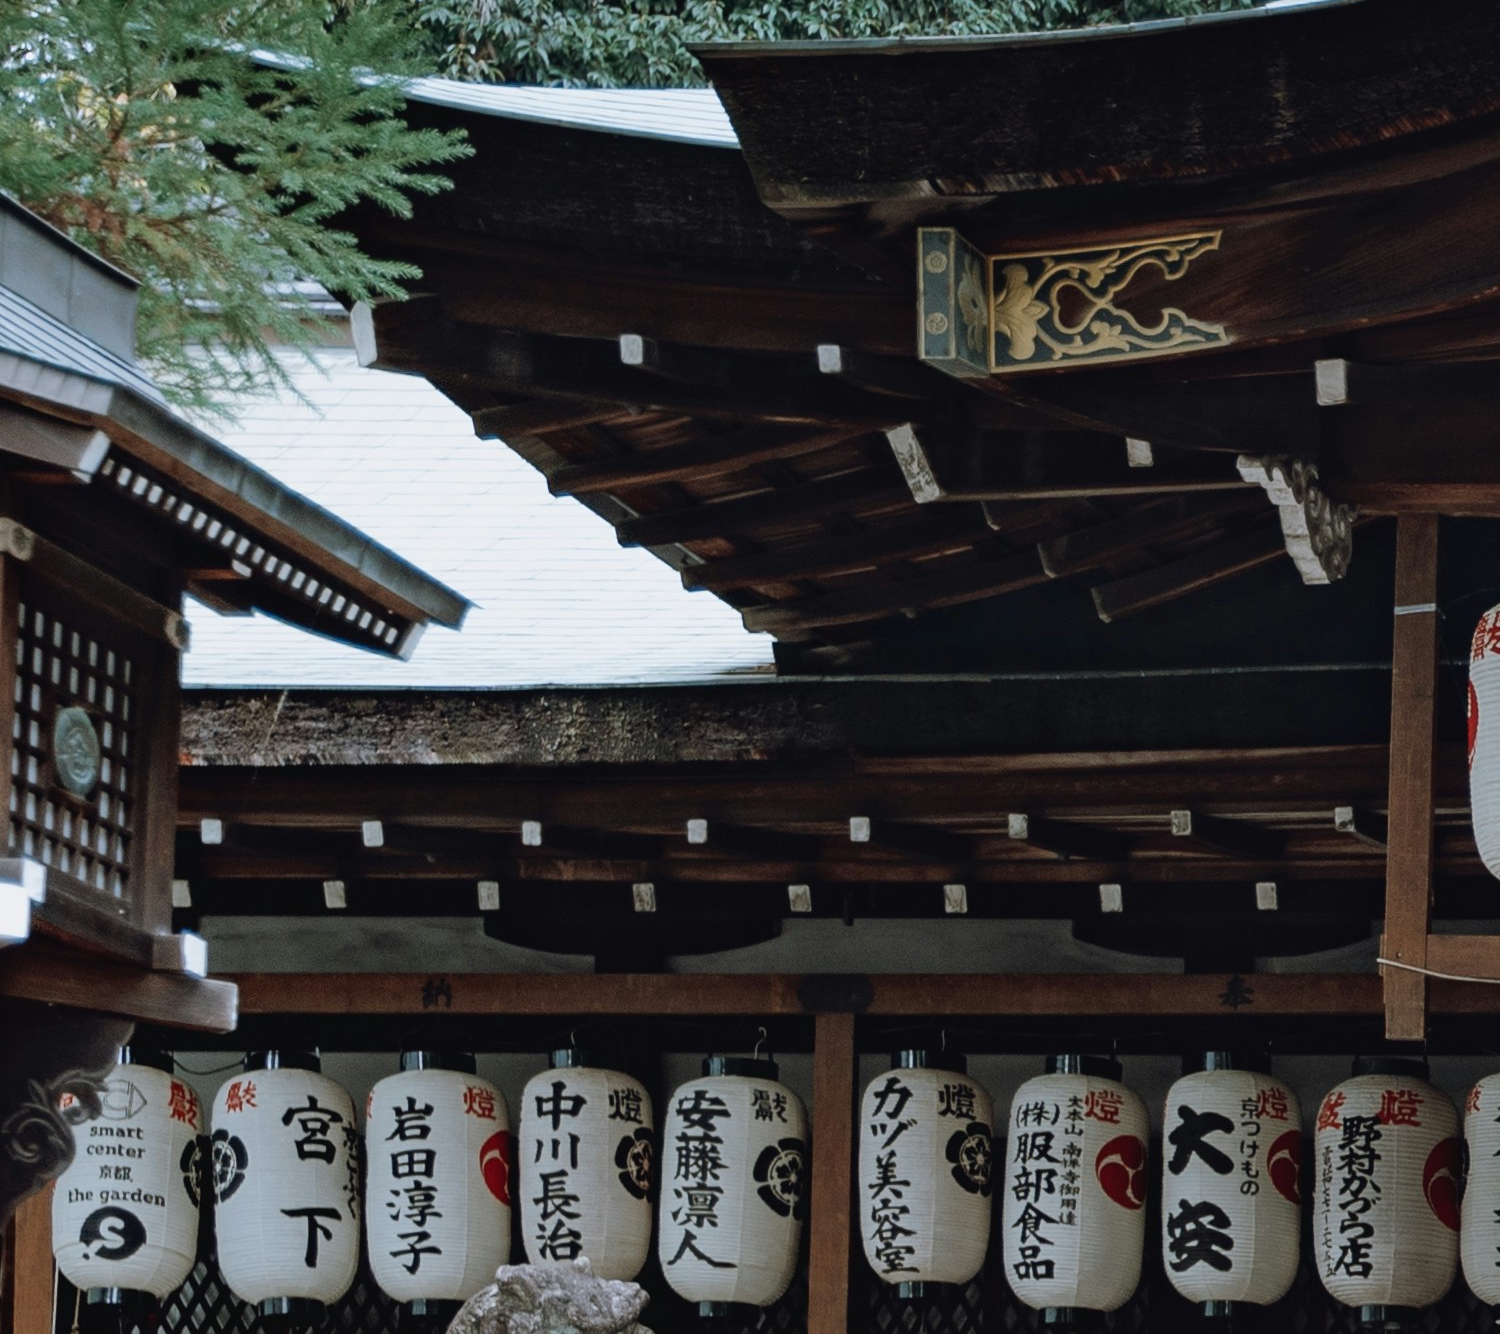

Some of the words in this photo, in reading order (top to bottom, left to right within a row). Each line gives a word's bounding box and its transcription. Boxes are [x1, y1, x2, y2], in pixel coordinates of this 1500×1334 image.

[68, 1189, 95, 1203] the
[100, 1190, 166, 1207] garden
[86, 1144, 147, 1159] center
[90, 1125, 144, 1140] smart
[280, 1095, 343, 1268] 宮下
[385, 1096, 442, 1276] 岩田淳子
[533, 1080, 587, 1261] 中川長治
[868, 1077, 920, 1274] カヅ美容室
[1168, 1104, 1235, 1273] 大安
[1240, 1097, 1260, 1195] 京つけもの
[1333, 1115, 1382, 1279] 野村かづら店
